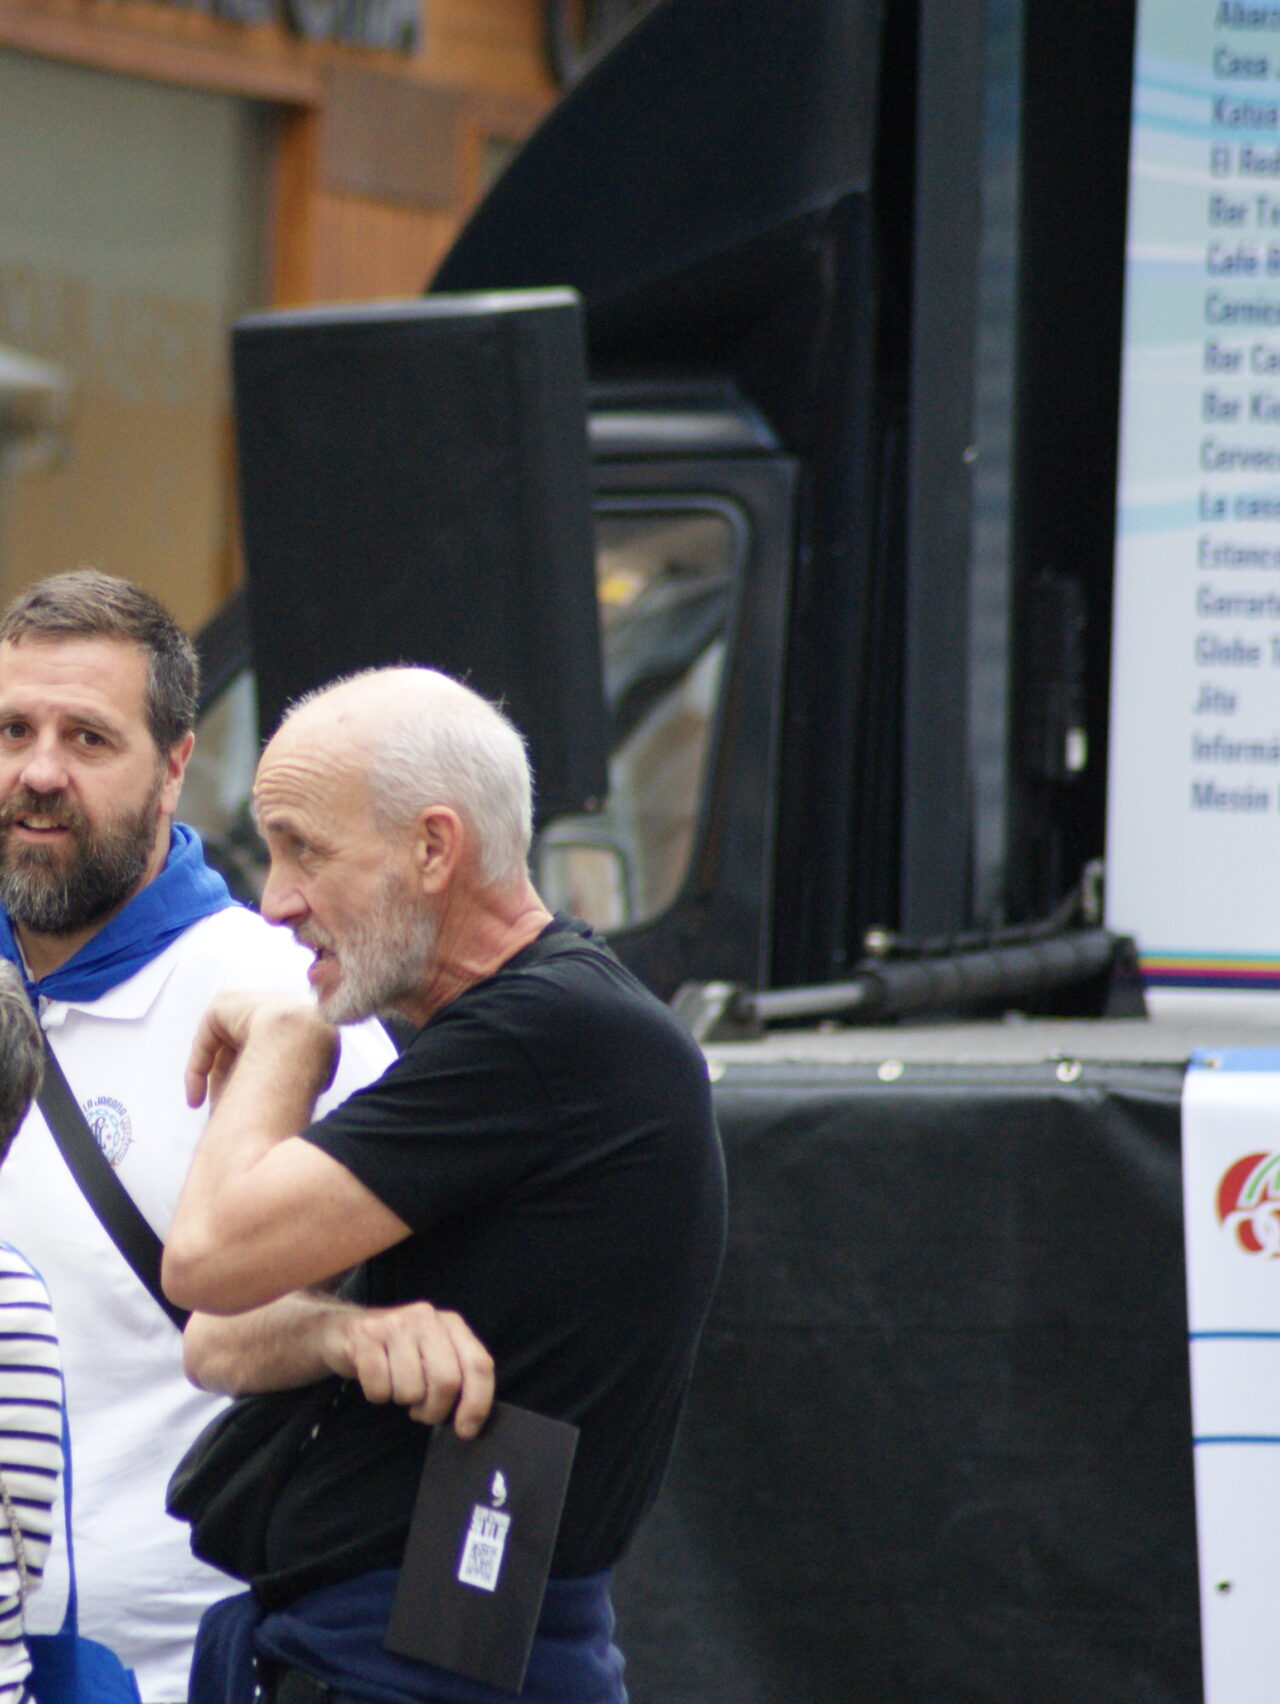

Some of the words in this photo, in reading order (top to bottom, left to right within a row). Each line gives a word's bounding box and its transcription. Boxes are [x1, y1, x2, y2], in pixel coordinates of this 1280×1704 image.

[1210, 194, 1245, 226] Bar
[1204, 340, 1240, 372] Bar
[1203, 390, 1239, 421] Bar
